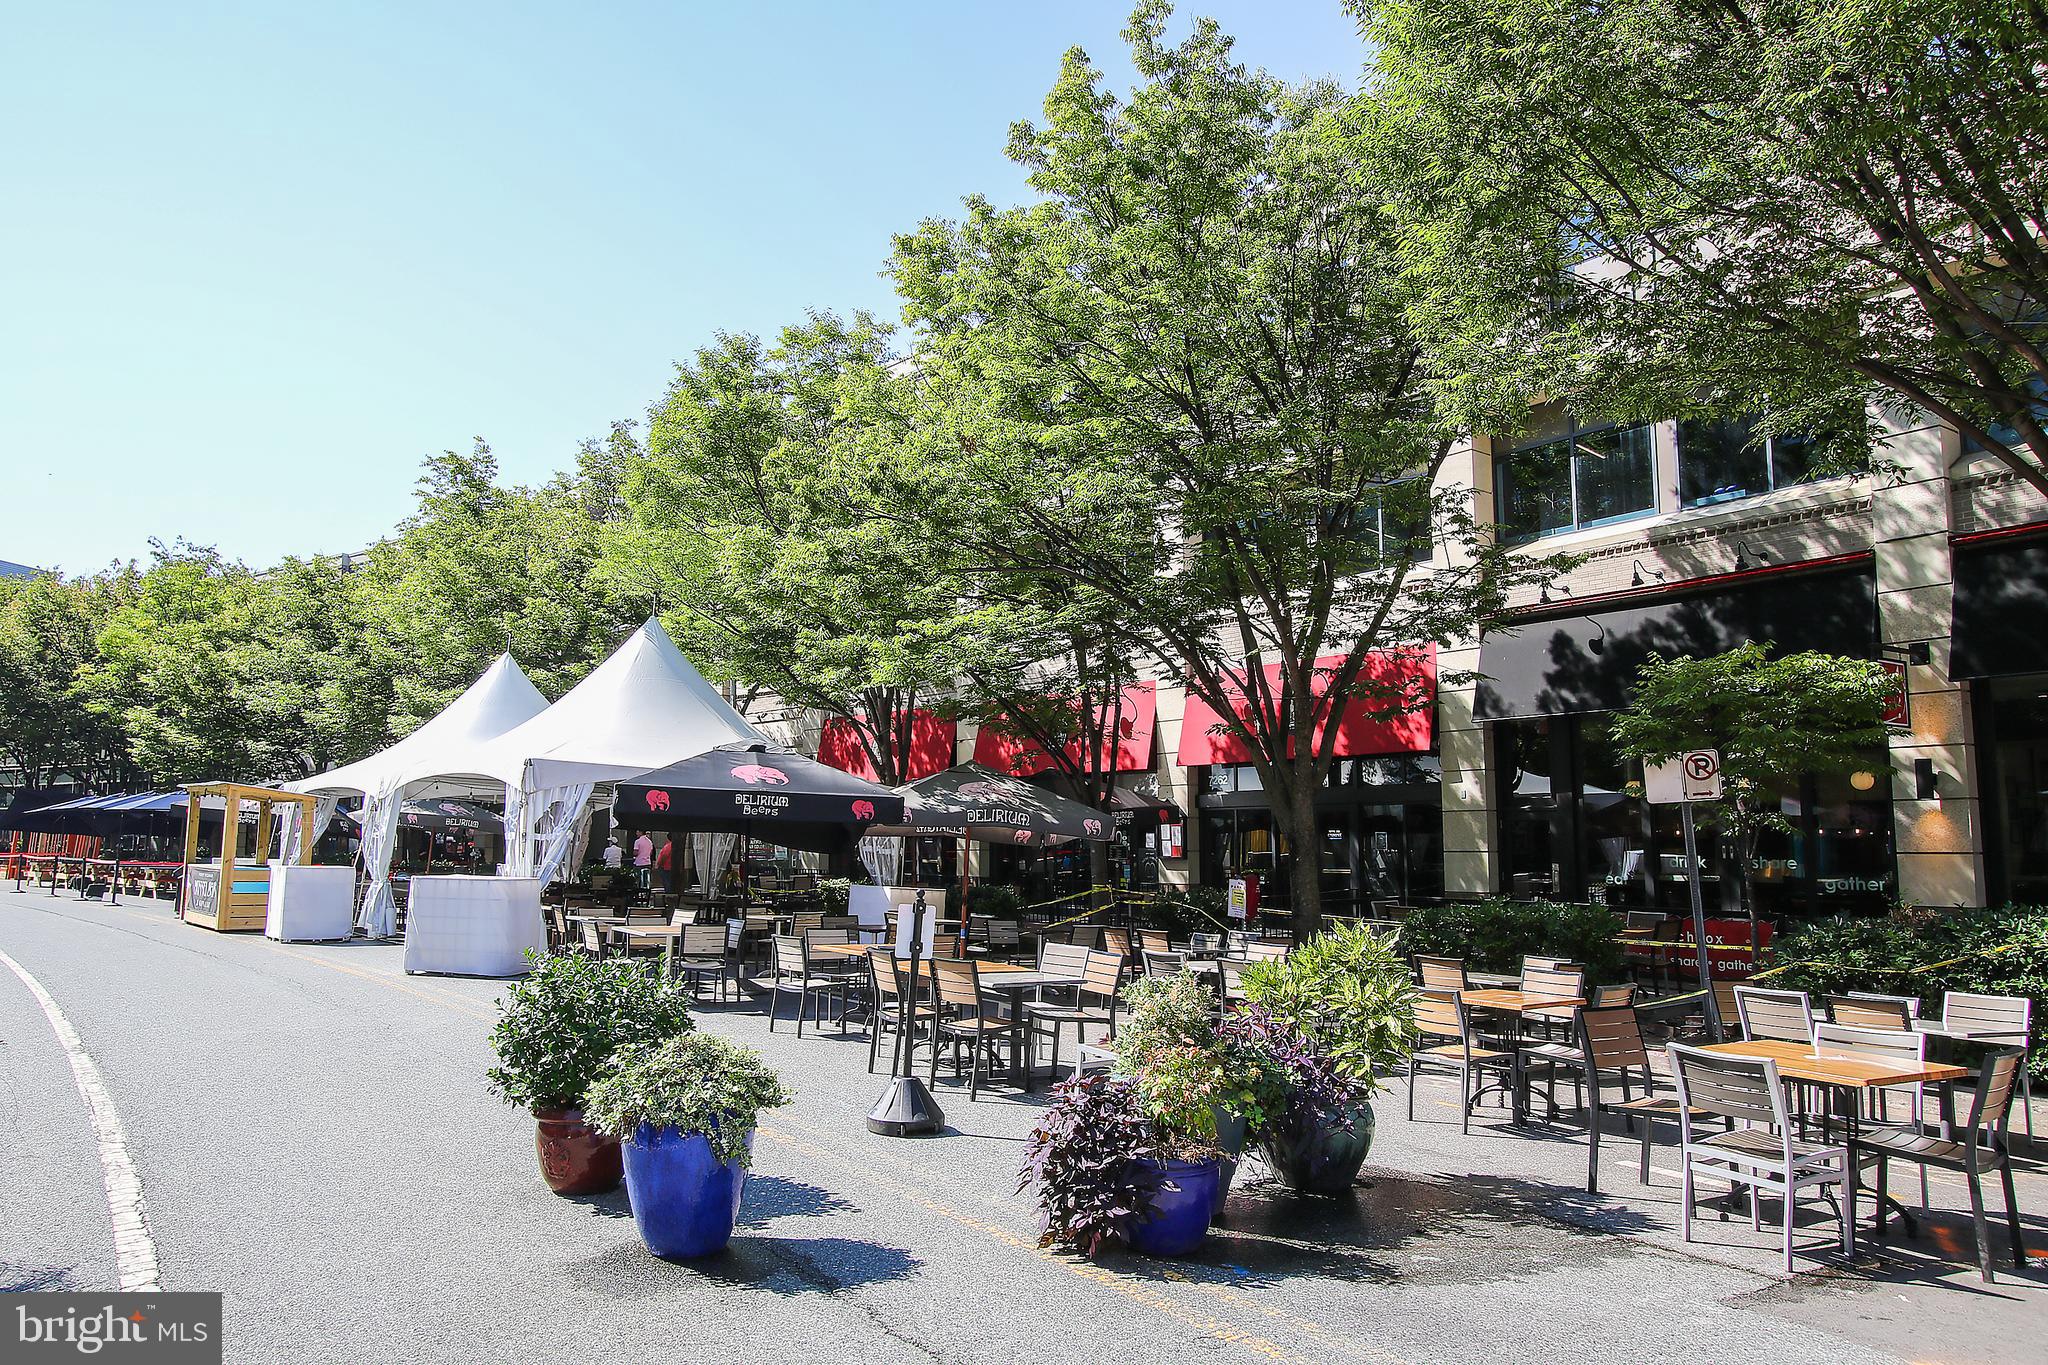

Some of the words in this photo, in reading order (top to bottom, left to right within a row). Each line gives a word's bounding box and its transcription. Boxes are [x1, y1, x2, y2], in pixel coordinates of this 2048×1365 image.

[1209, 775, 1228, 786] 7262
[735, 793, 789, 807] DELIRIUM
[742, 805, 779, 816] Beers
[967, 809, 1030, 827] DELIRIUM
[1671, 855, 1707, 869] drik
[1752, 856, 1798, 869] share
[1824, 876, 1886, 893] gather
[1717, 960, 1753, 971] gathe
